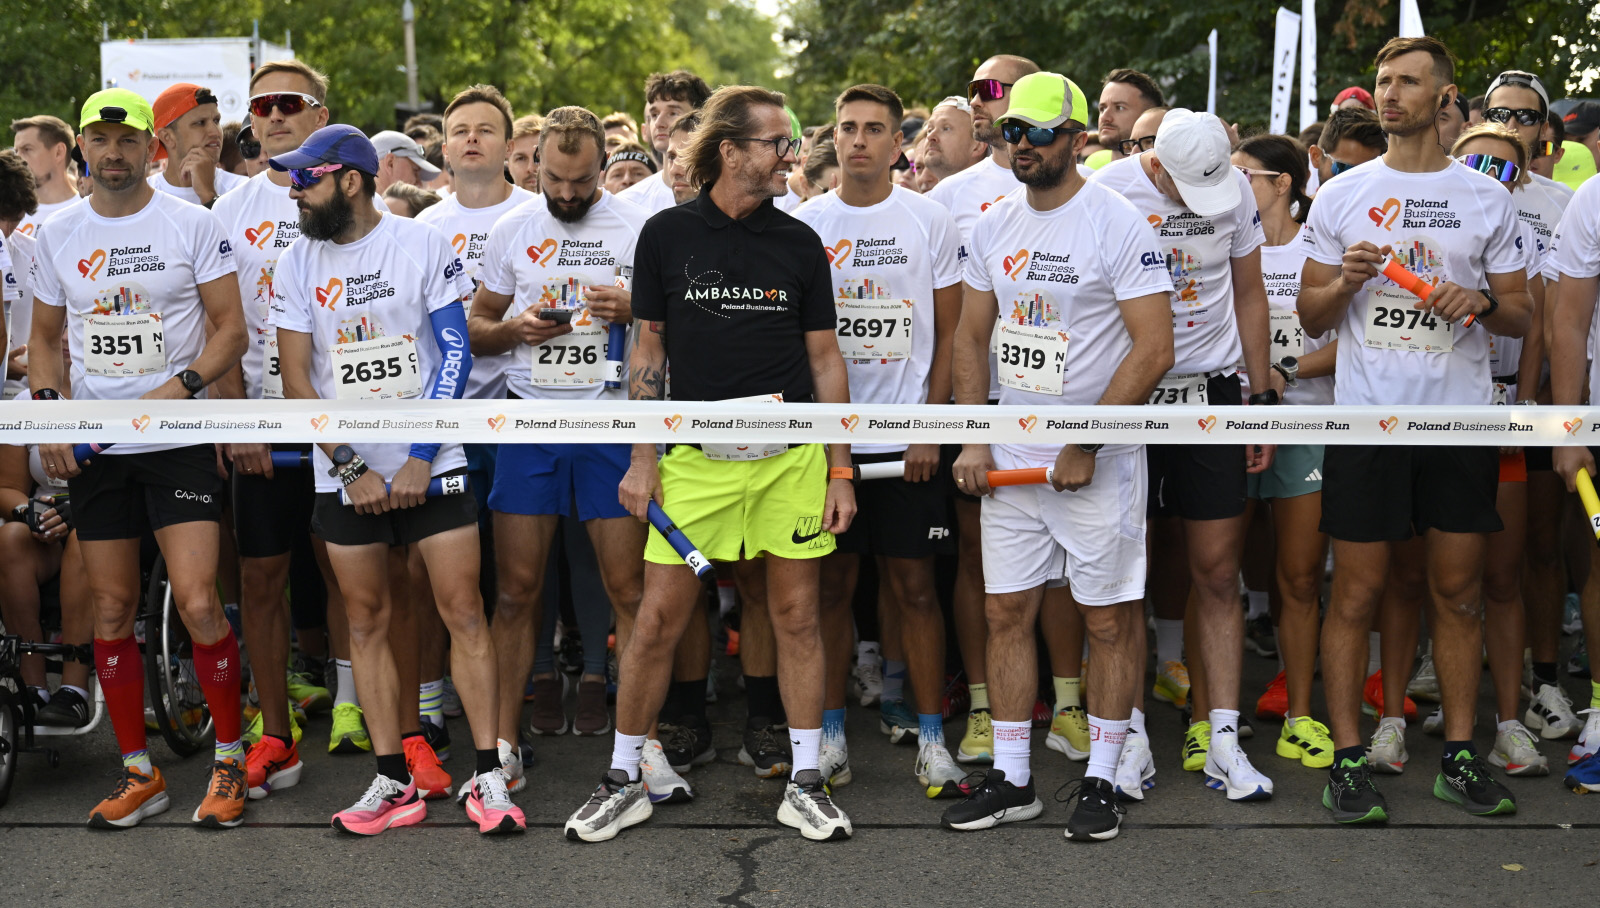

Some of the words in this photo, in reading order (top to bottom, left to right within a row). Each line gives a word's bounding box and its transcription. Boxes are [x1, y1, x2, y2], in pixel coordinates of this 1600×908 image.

[1405, 199, 1448, 208] Poland
[1404, 209, 1456, 218] Business
[1517, 210, 1541, 220] land
[1402, 219, 1426, 228] Run
[1428, 219, 1461, 228] 2026
[276, 230, 301, 239] Busi
[1160, 229, 1183, 237] Run
[1186, 226, 1215, 236] 2026
[470, 233, 488, 241] Pol
[219, 240, 233, 254] GL
[273, 240, 292, 248] Ru
[562, 240, 603, 248] Poland
[856, 237, 896, 248] Poland
[110, 245, 151, 257] Poland
[466, 251, 485, 260] Ru
[560, 248, 611, 257] Business
[854, 247, 903, 258] Business
[109, 254, 159, 267] Business
[557, 258, 581, 266] Run
[584, 257, 615, 266] 2026
[852, 259, 875, 267] Run
[877, 255, 908, 265] 2026
[1031, 251, 1070, 263] Poland
[107, 265, 131, 277] Run
[133, 262, 166, 273] 2026
[1029, 261, 1075, 274] Business
[1026, 271, 1047, 281] Run
[1048, 273, 1079, 284] 2026
[366, 288, 395, 302] 2026
[1277, 288, 1300, 297] 202
[904, 318, 911, 326] D
[1373, 306, 1437, 330] 2974
[838, 318, 896, 338] 2697
[1446, 323, 1451, 331] 1
[153, 332, 162, 342] N
[905, 329, 909, 338] 1
[1295, 328, 1303, 337] X
[91, 335, 143, 355] 3351
[1296, 339, 1301, 347] 1
[156, 344, 161, 353] 1
[408, 353, 416, 362] C
[539, 345, 597, 365] 2736
[1001, 343, 1045, 369] 3319
[1055, 351, 1064, 362] N
[341, 357, 402, 384] 2635
[411, 365, 416, 374] 1
[1056, 364, 1060, 373] 1
[1198, 384, 1205, 392] D
[1146, 387, 1189, 404] 731
[1199, 394, 1204, 402] 1
[0, 421, 22, 430] and
[24, 420, 76, 430] Business
[78, 420, 103, 430] Run
[159, 420, 202, 430] Poland
[204, 420, 256, 430] Business
[257, 420, 283, 430] Run
[337, 419, 380, 430] Poland
[381, 419, 433, 430] Business
[434, 419, 460, 430] Run
[514, 419, 557, 430] Poland
[558, 419, 610, 430] Business
[611, 419, 636, 430] Run
[691, 419, 734, 430] Poland
[735, 419, 787, 430] Business
[788, 419, 813, 430] Run
[868, 419, 911, 430] Poland
[912, 419, 964, 430] Business
[965, 419, 990, 430] Run
[1046, 420, 1089, 430] Poland
[1090, 420, 1143, 430] Business
[1144, 420, 1169, 430] Run
[1225, 420, 1269, 430] Poland
[1270, 420, 1324, 430] Business
[1325, 420, 1350, 430] Run
[1407, 421, 1451, 431] Poland
[1452, 421, 1506, 431] Business
[1508, 422, 1533, 432] Run
